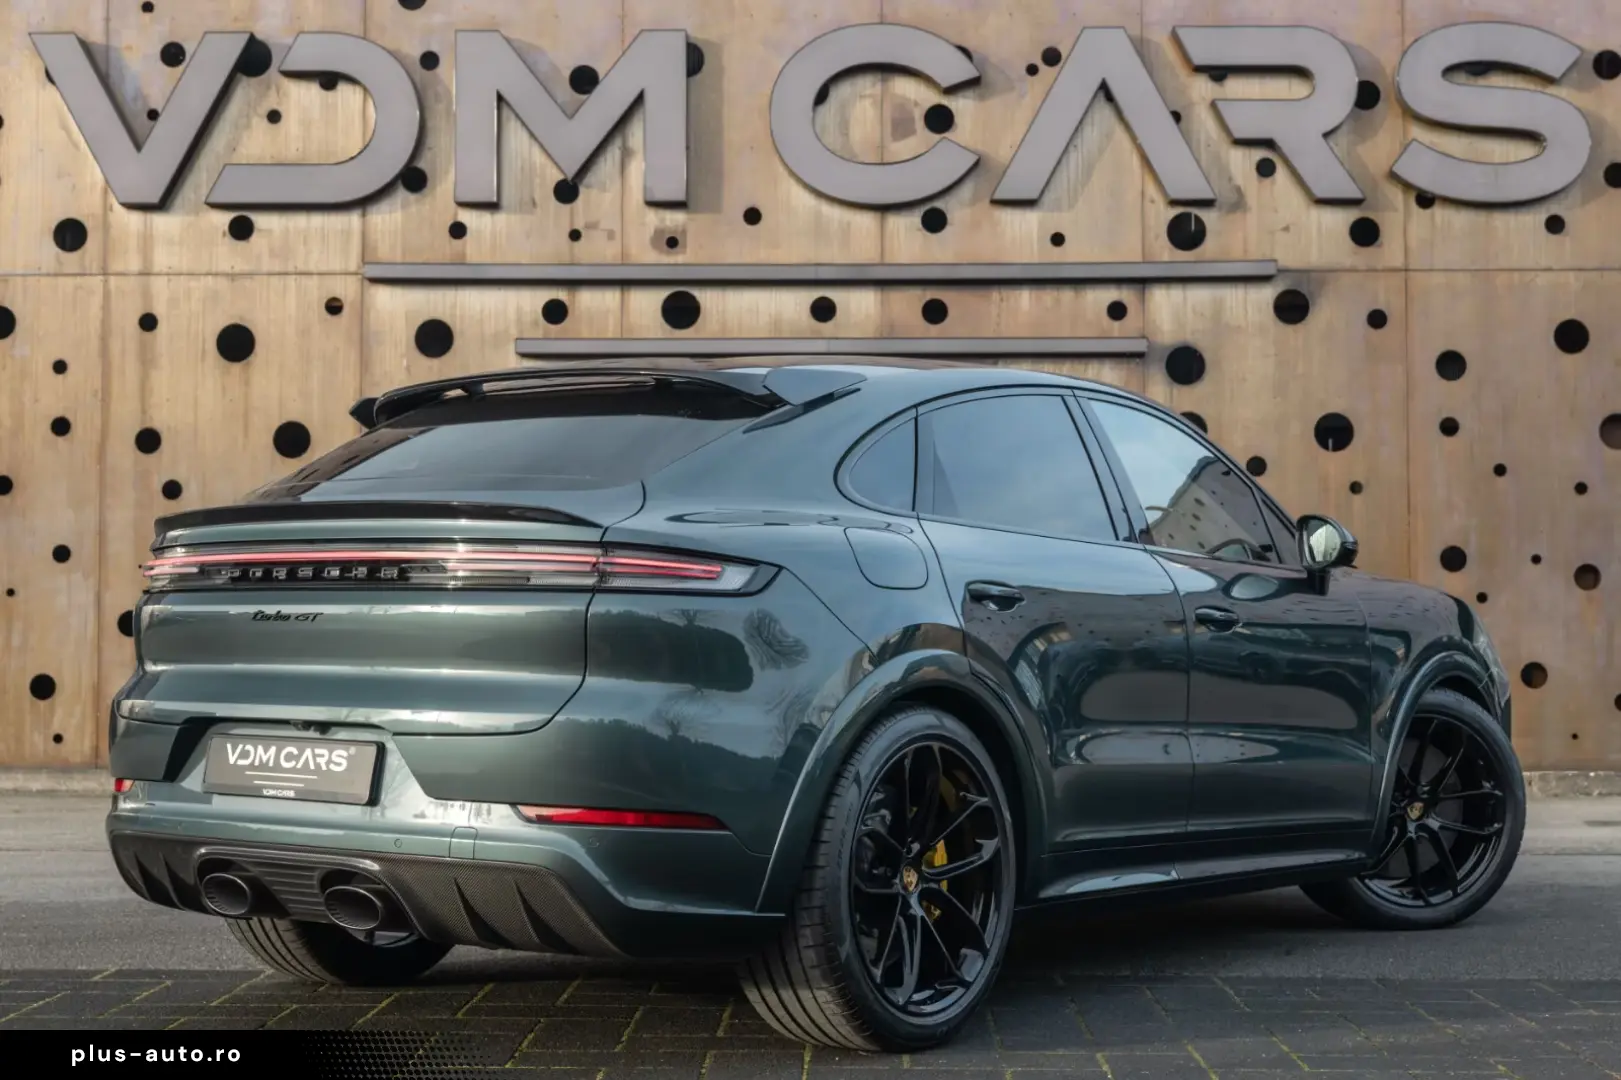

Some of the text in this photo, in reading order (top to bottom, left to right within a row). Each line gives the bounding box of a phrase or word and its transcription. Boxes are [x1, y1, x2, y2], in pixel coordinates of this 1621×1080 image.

[28, 22, 1591, 210] VDM CARS
[294, 612, 325, 622] GT
[226, 743, 276, 767] VDM
